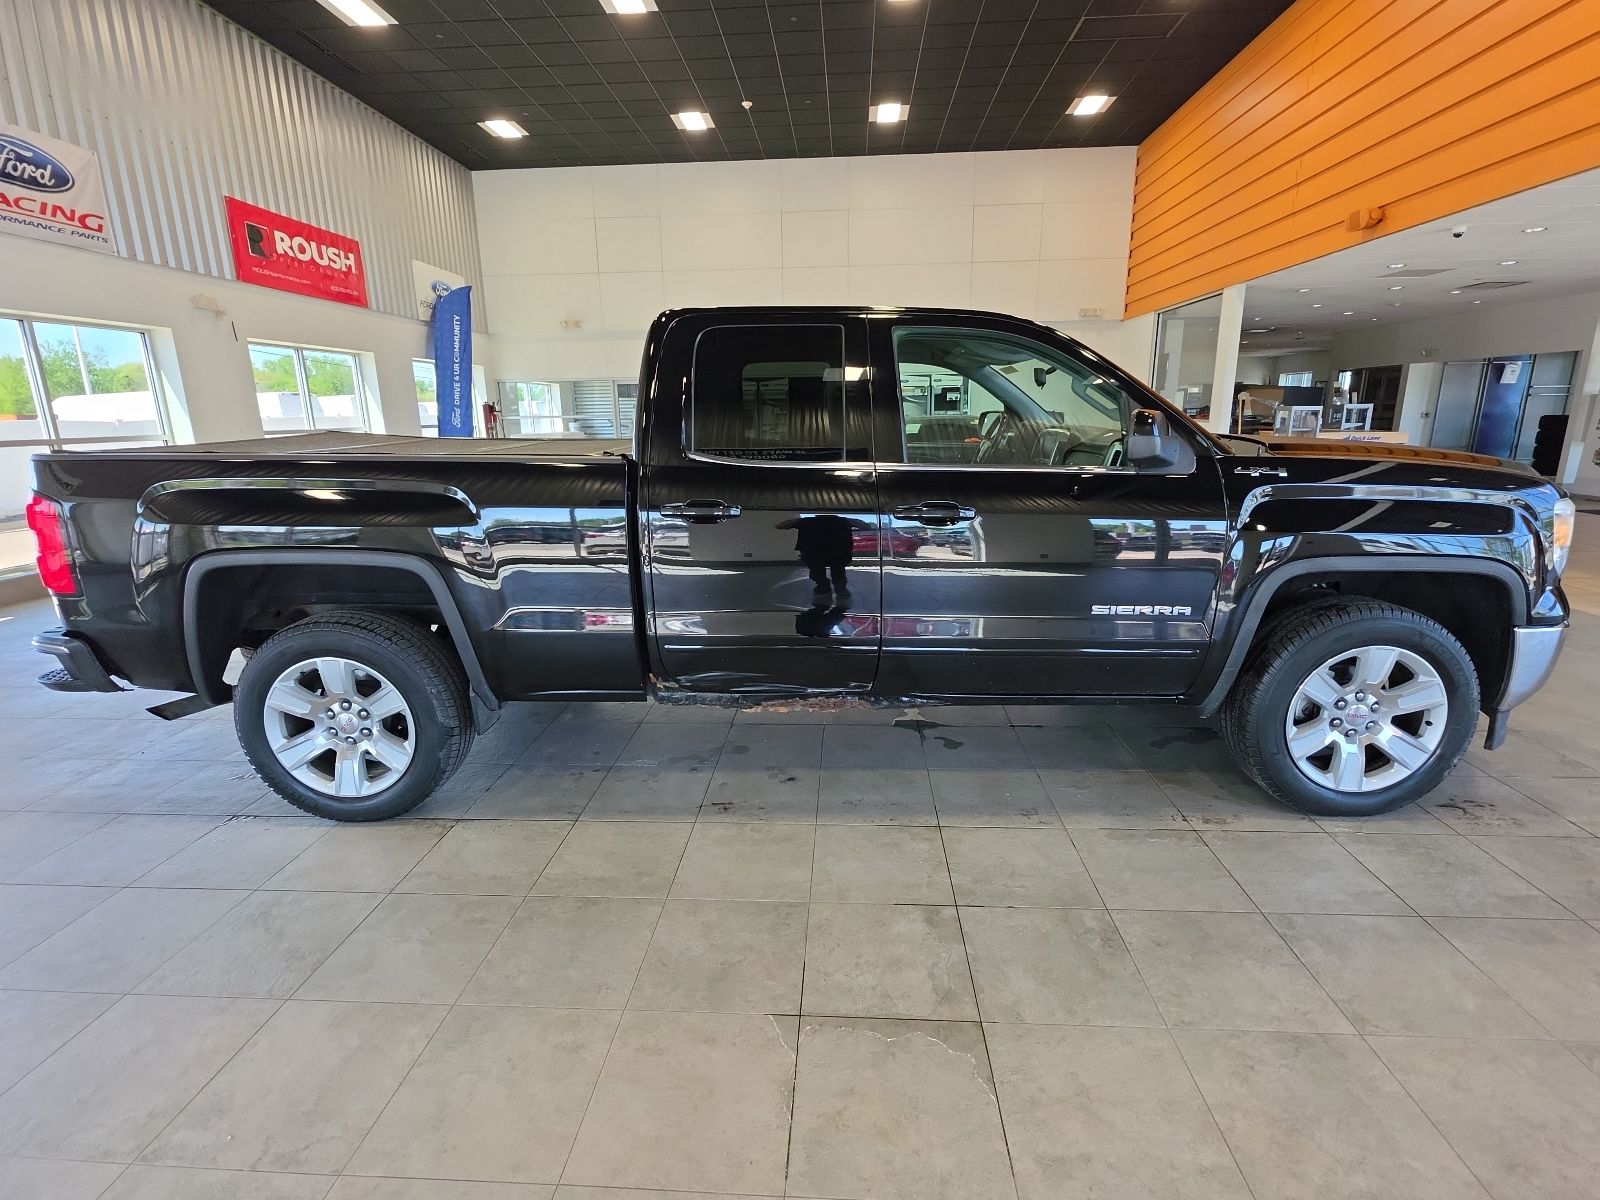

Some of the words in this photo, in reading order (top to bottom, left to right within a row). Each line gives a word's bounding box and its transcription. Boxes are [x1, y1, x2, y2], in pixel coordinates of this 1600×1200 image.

[0, 141, 55, 186] Ford
[70, 230, 109, 244] PARTS
[274, 229, 356, 274] ROUSH
[420, 300, 433, 309] FORD
[453, 314, 461, 362] COMMUNITY
[453, 363, 460, 375] UR
[453, 382, 461, 405] DRIVE
[451, 408, 461, 428] Ford
[1091, 605, 1192, 616] SIERRA
